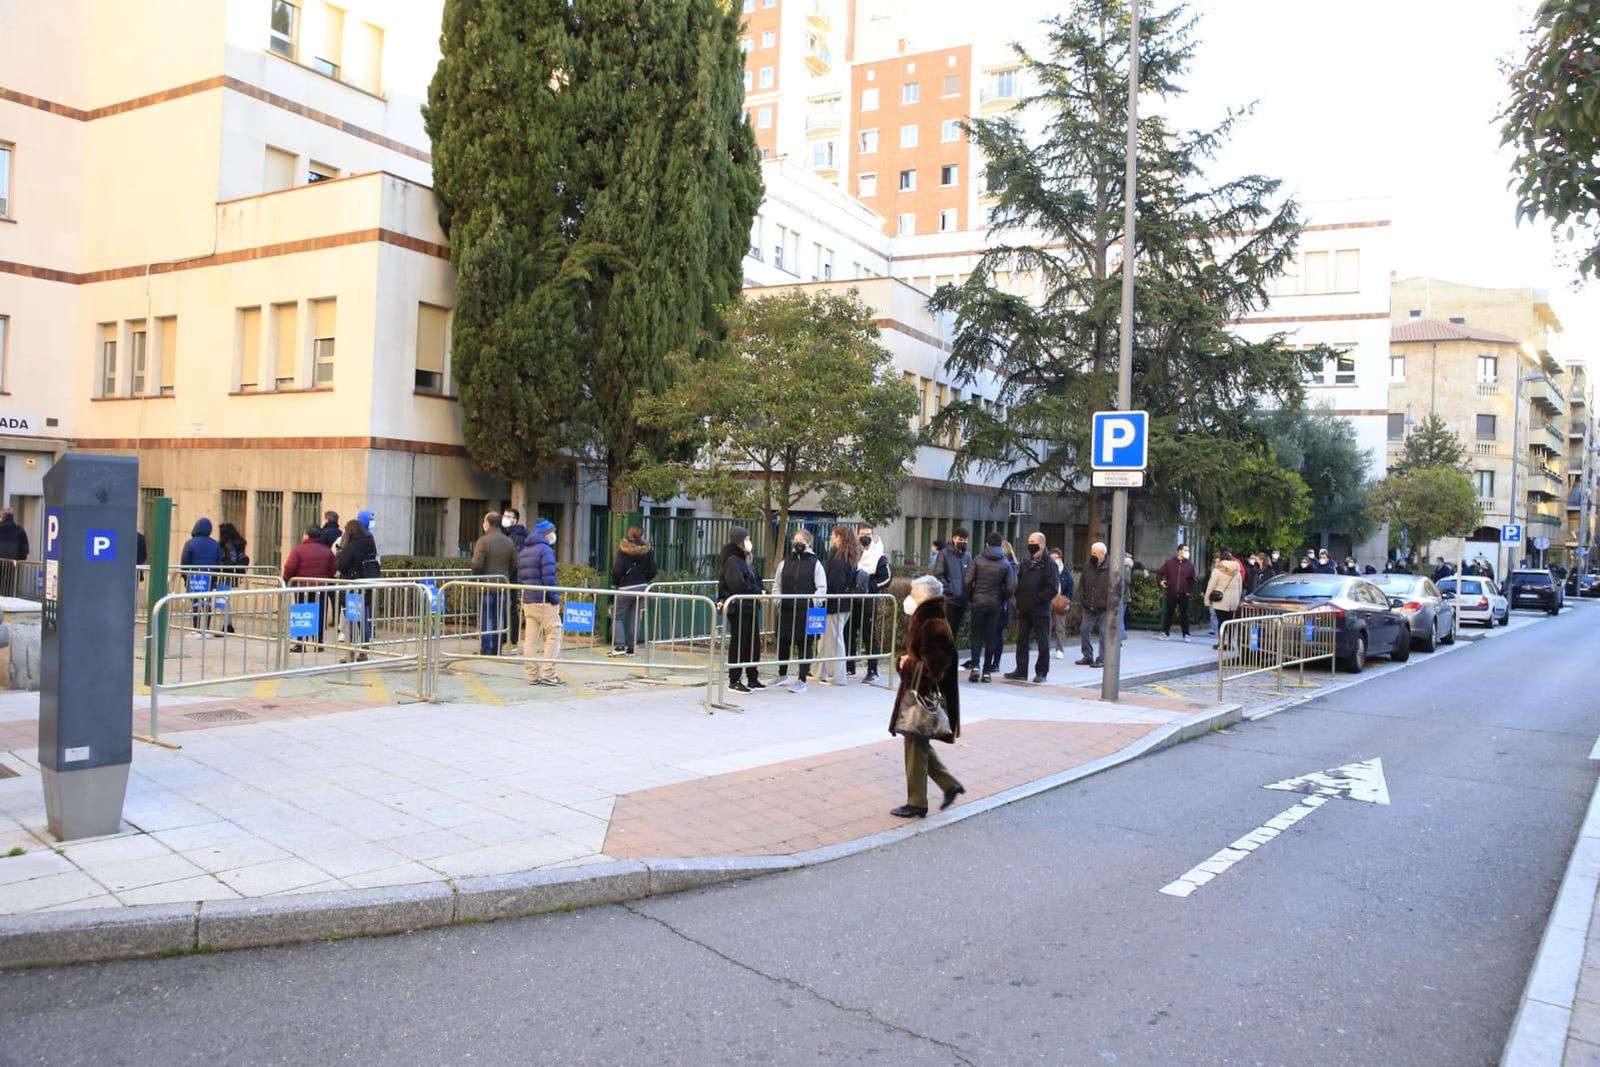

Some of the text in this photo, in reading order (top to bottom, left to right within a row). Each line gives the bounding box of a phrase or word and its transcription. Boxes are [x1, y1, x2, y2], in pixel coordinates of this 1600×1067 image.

[0, 417, 28, 429] ADA
[1103, 418, 1135, 462] P
[47, 515, 59, 551] P
[1505, 526, 1518, 540] P
[93, 536, 111, 555] P
[290, 620, 312, 628] LOCAL
[567, 616, 590, 624] LOCAL
